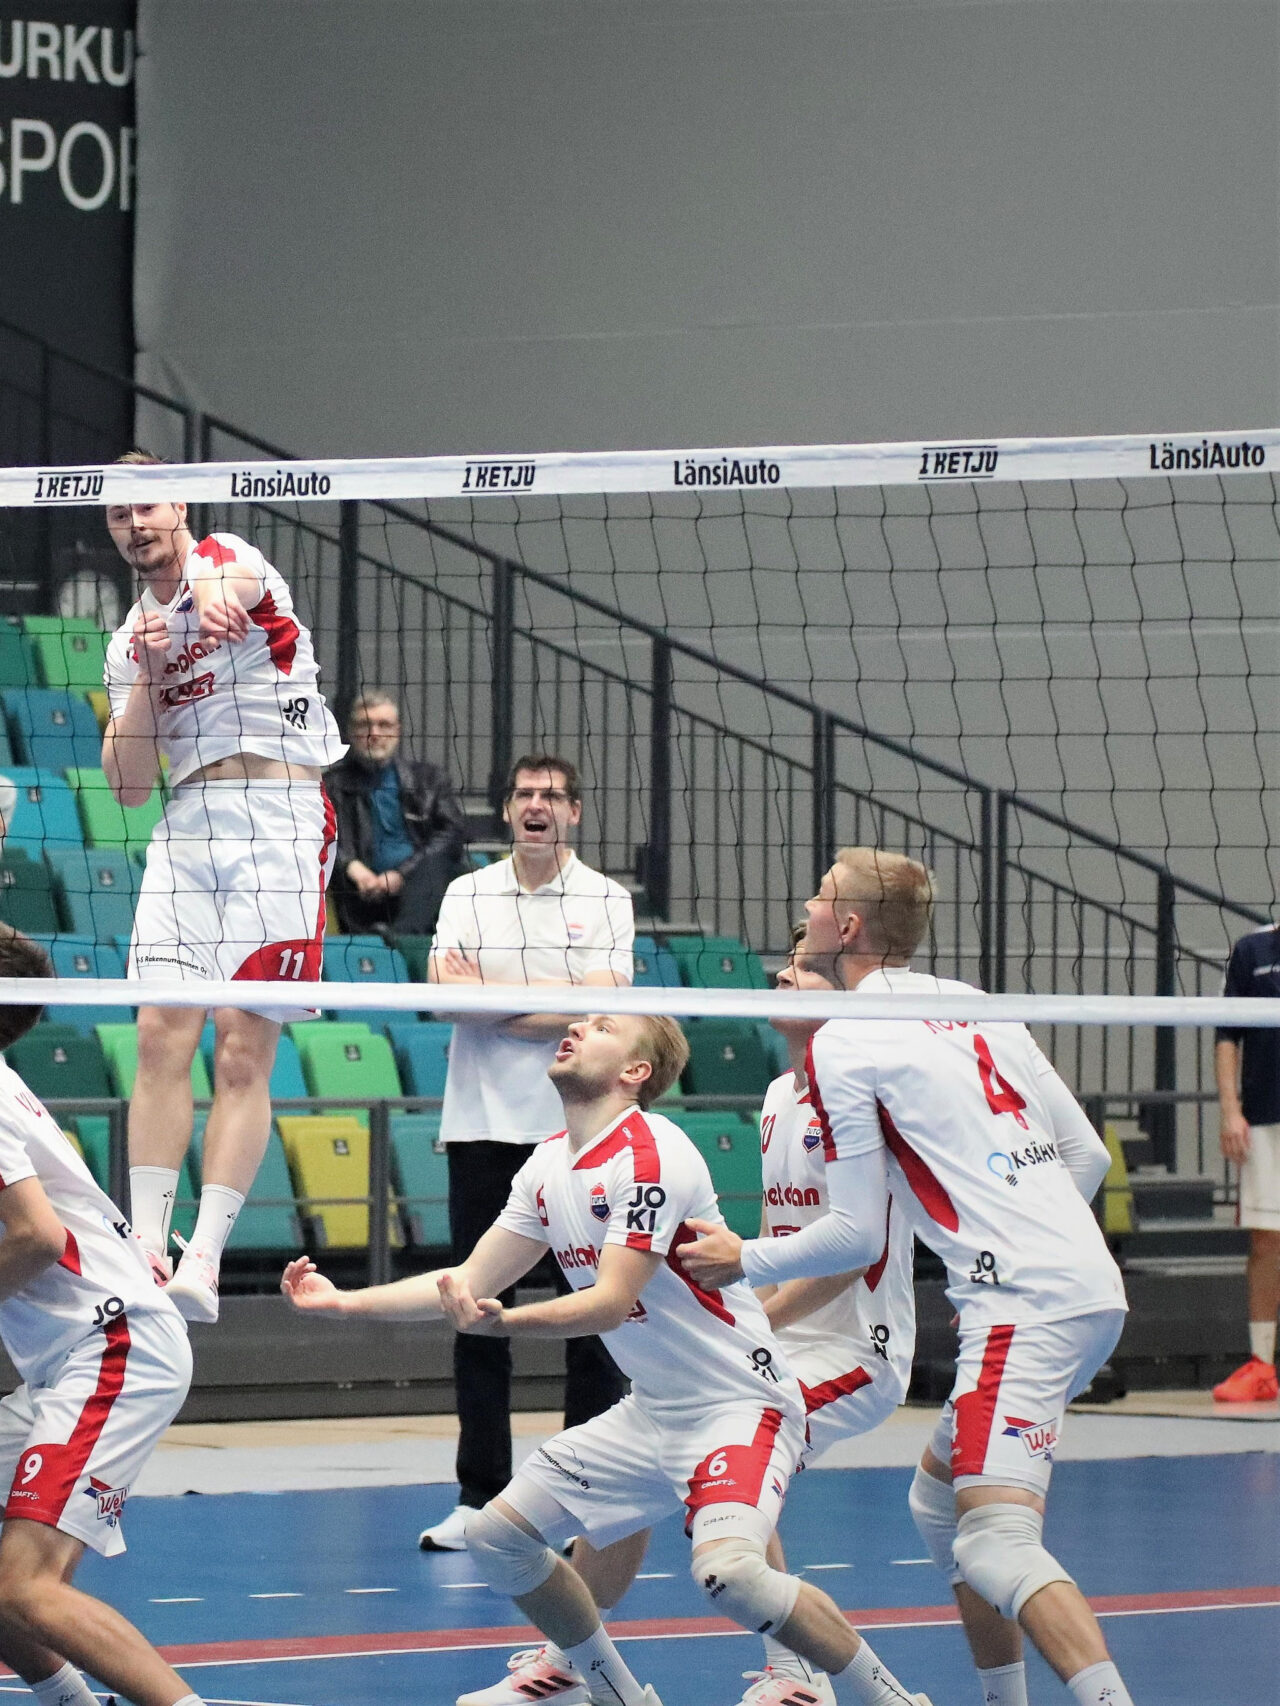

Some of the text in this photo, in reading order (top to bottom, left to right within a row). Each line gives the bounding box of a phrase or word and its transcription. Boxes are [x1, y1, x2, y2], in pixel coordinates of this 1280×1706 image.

[1150, 440, 1266, 470] LänsiAuto
[231, 469, 331, 497] LänsiAuto
[674, 457, 781, 486] LänsiAuto
[282, 697, 310, 715] JO
[278, 948, 305, 980] 11
[972, 1033, 1030, 1130] 4
[627, 1185, 667, 1209] JO
[626, 1208, 657, 1232] KI
[969, 1251, 995, 1274] JO
[92, 1296, 125, 1326] JO
[20, 1453, 43, 1486] 9
[707, 1451, 728, 1478] 6
[703, 1514, 737, 1527] CRAFT
